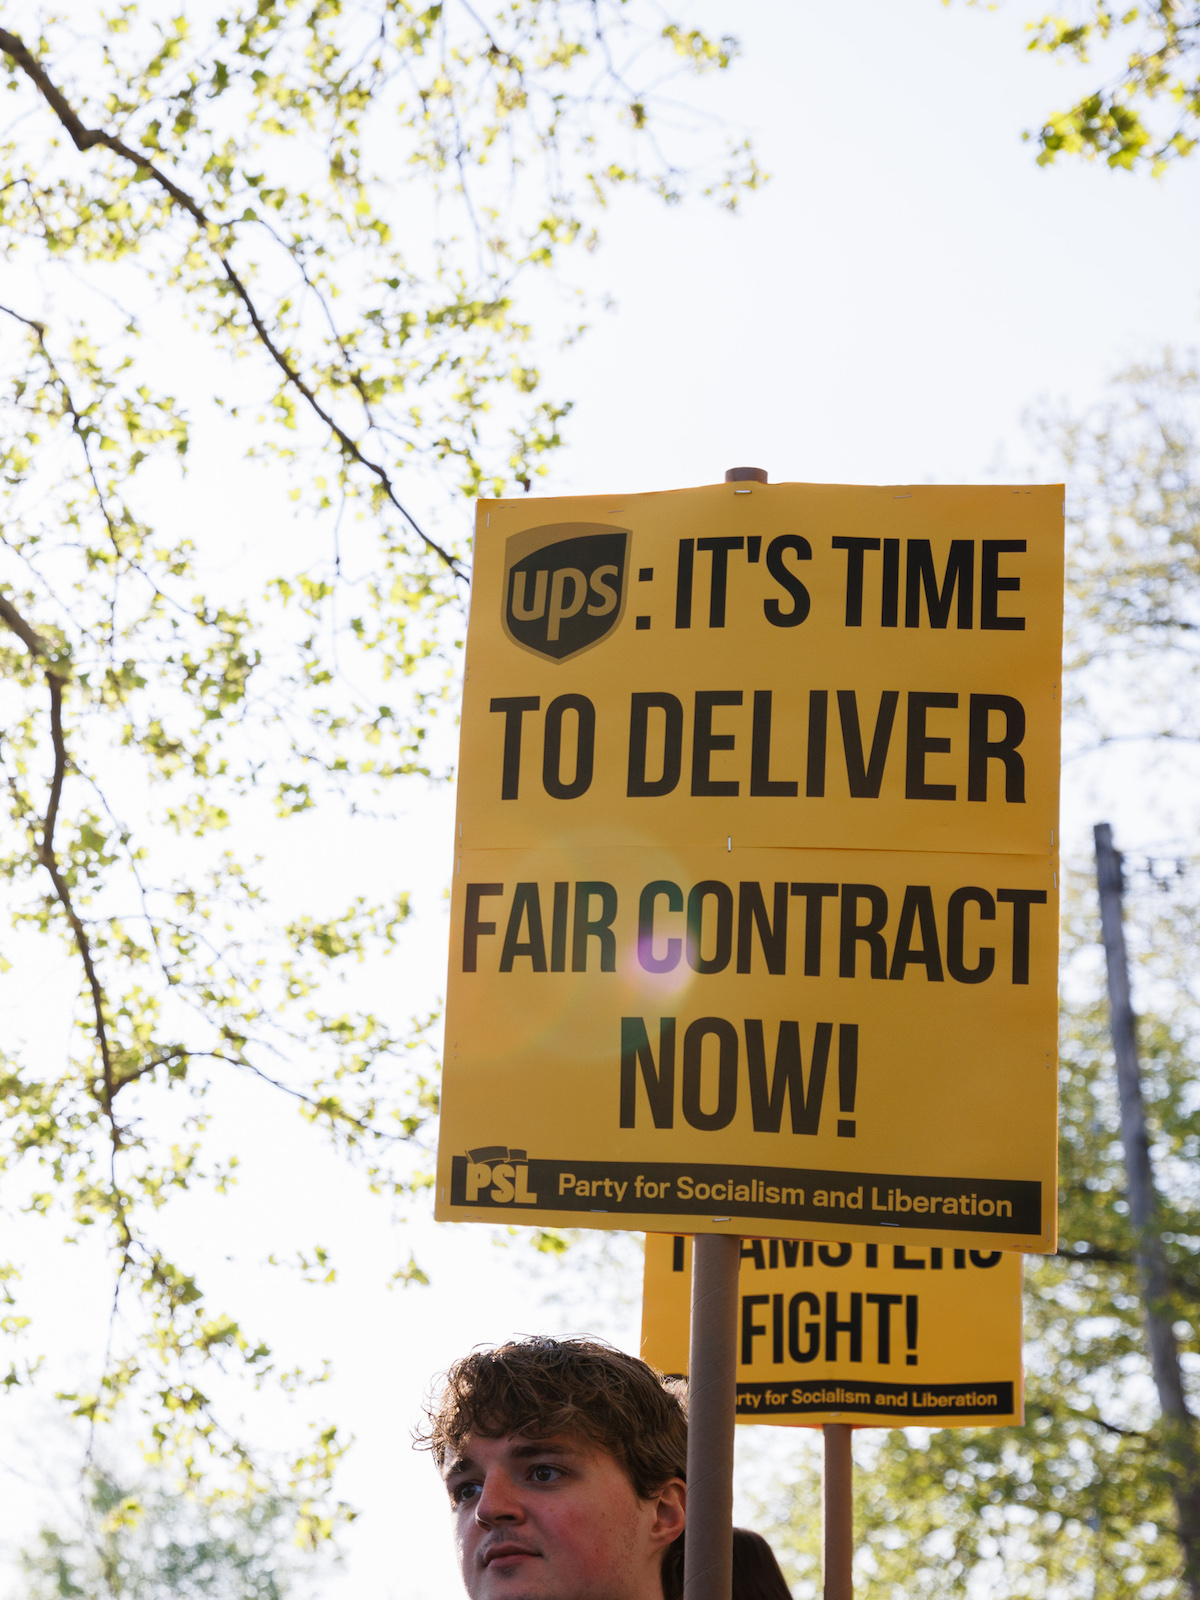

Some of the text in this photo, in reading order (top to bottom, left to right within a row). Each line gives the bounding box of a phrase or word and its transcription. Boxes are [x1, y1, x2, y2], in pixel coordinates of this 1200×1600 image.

[675, 534, 812, 629] IT'S
[832, 535, 1027, 631] TIME
[490, 690, 1027, 804] TO DELIVER
[461, 880, 1048, 985] FAIR CONTRACT
[619, 1016, 860, 1138] NOW!
[465, 1162, 1013, 1218] PSL Party for Socialism and Liberation
[741, 1291, 919, 1366] FIGHT!
[736, 1387, 998, 1409] rty for Socialism and Liberation
